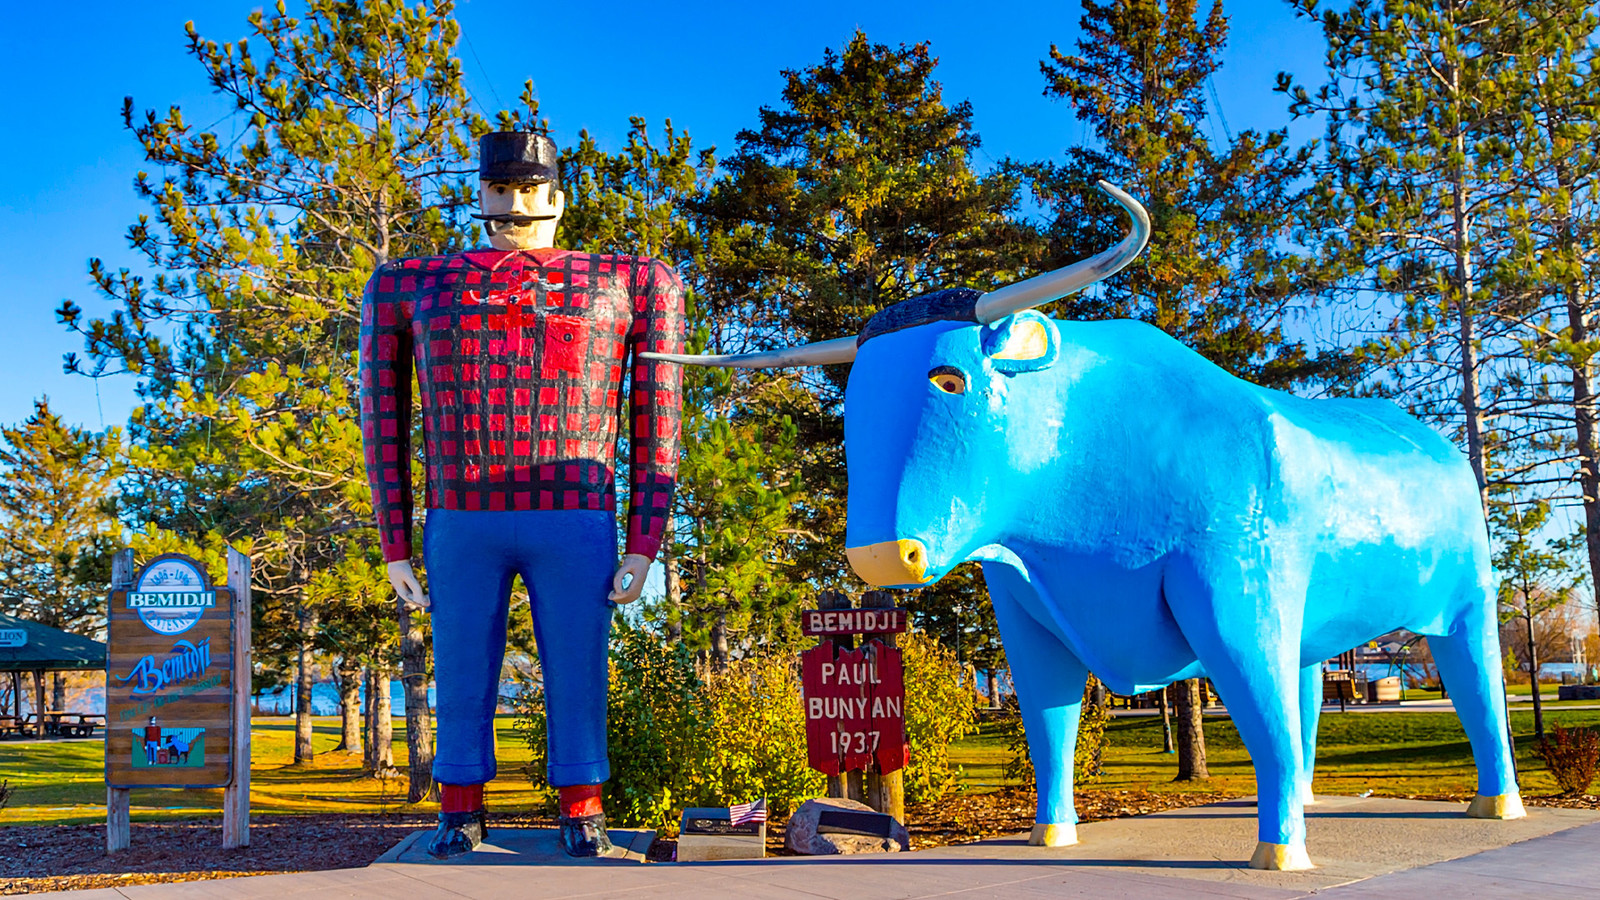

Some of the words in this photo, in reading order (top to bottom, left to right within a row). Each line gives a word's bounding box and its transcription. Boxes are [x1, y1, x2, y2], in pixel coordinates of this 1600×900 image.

[130, 593, 213, 607] BEMIDJI
[809, 611, 898, 632] BEMIDJI
[115, 636, 213, 695] Bemidji
[821, 662, 882, 685] PAUL
[809, 696, 901, 720] BUNYAN
[830, 731, 881, 754] 1937
